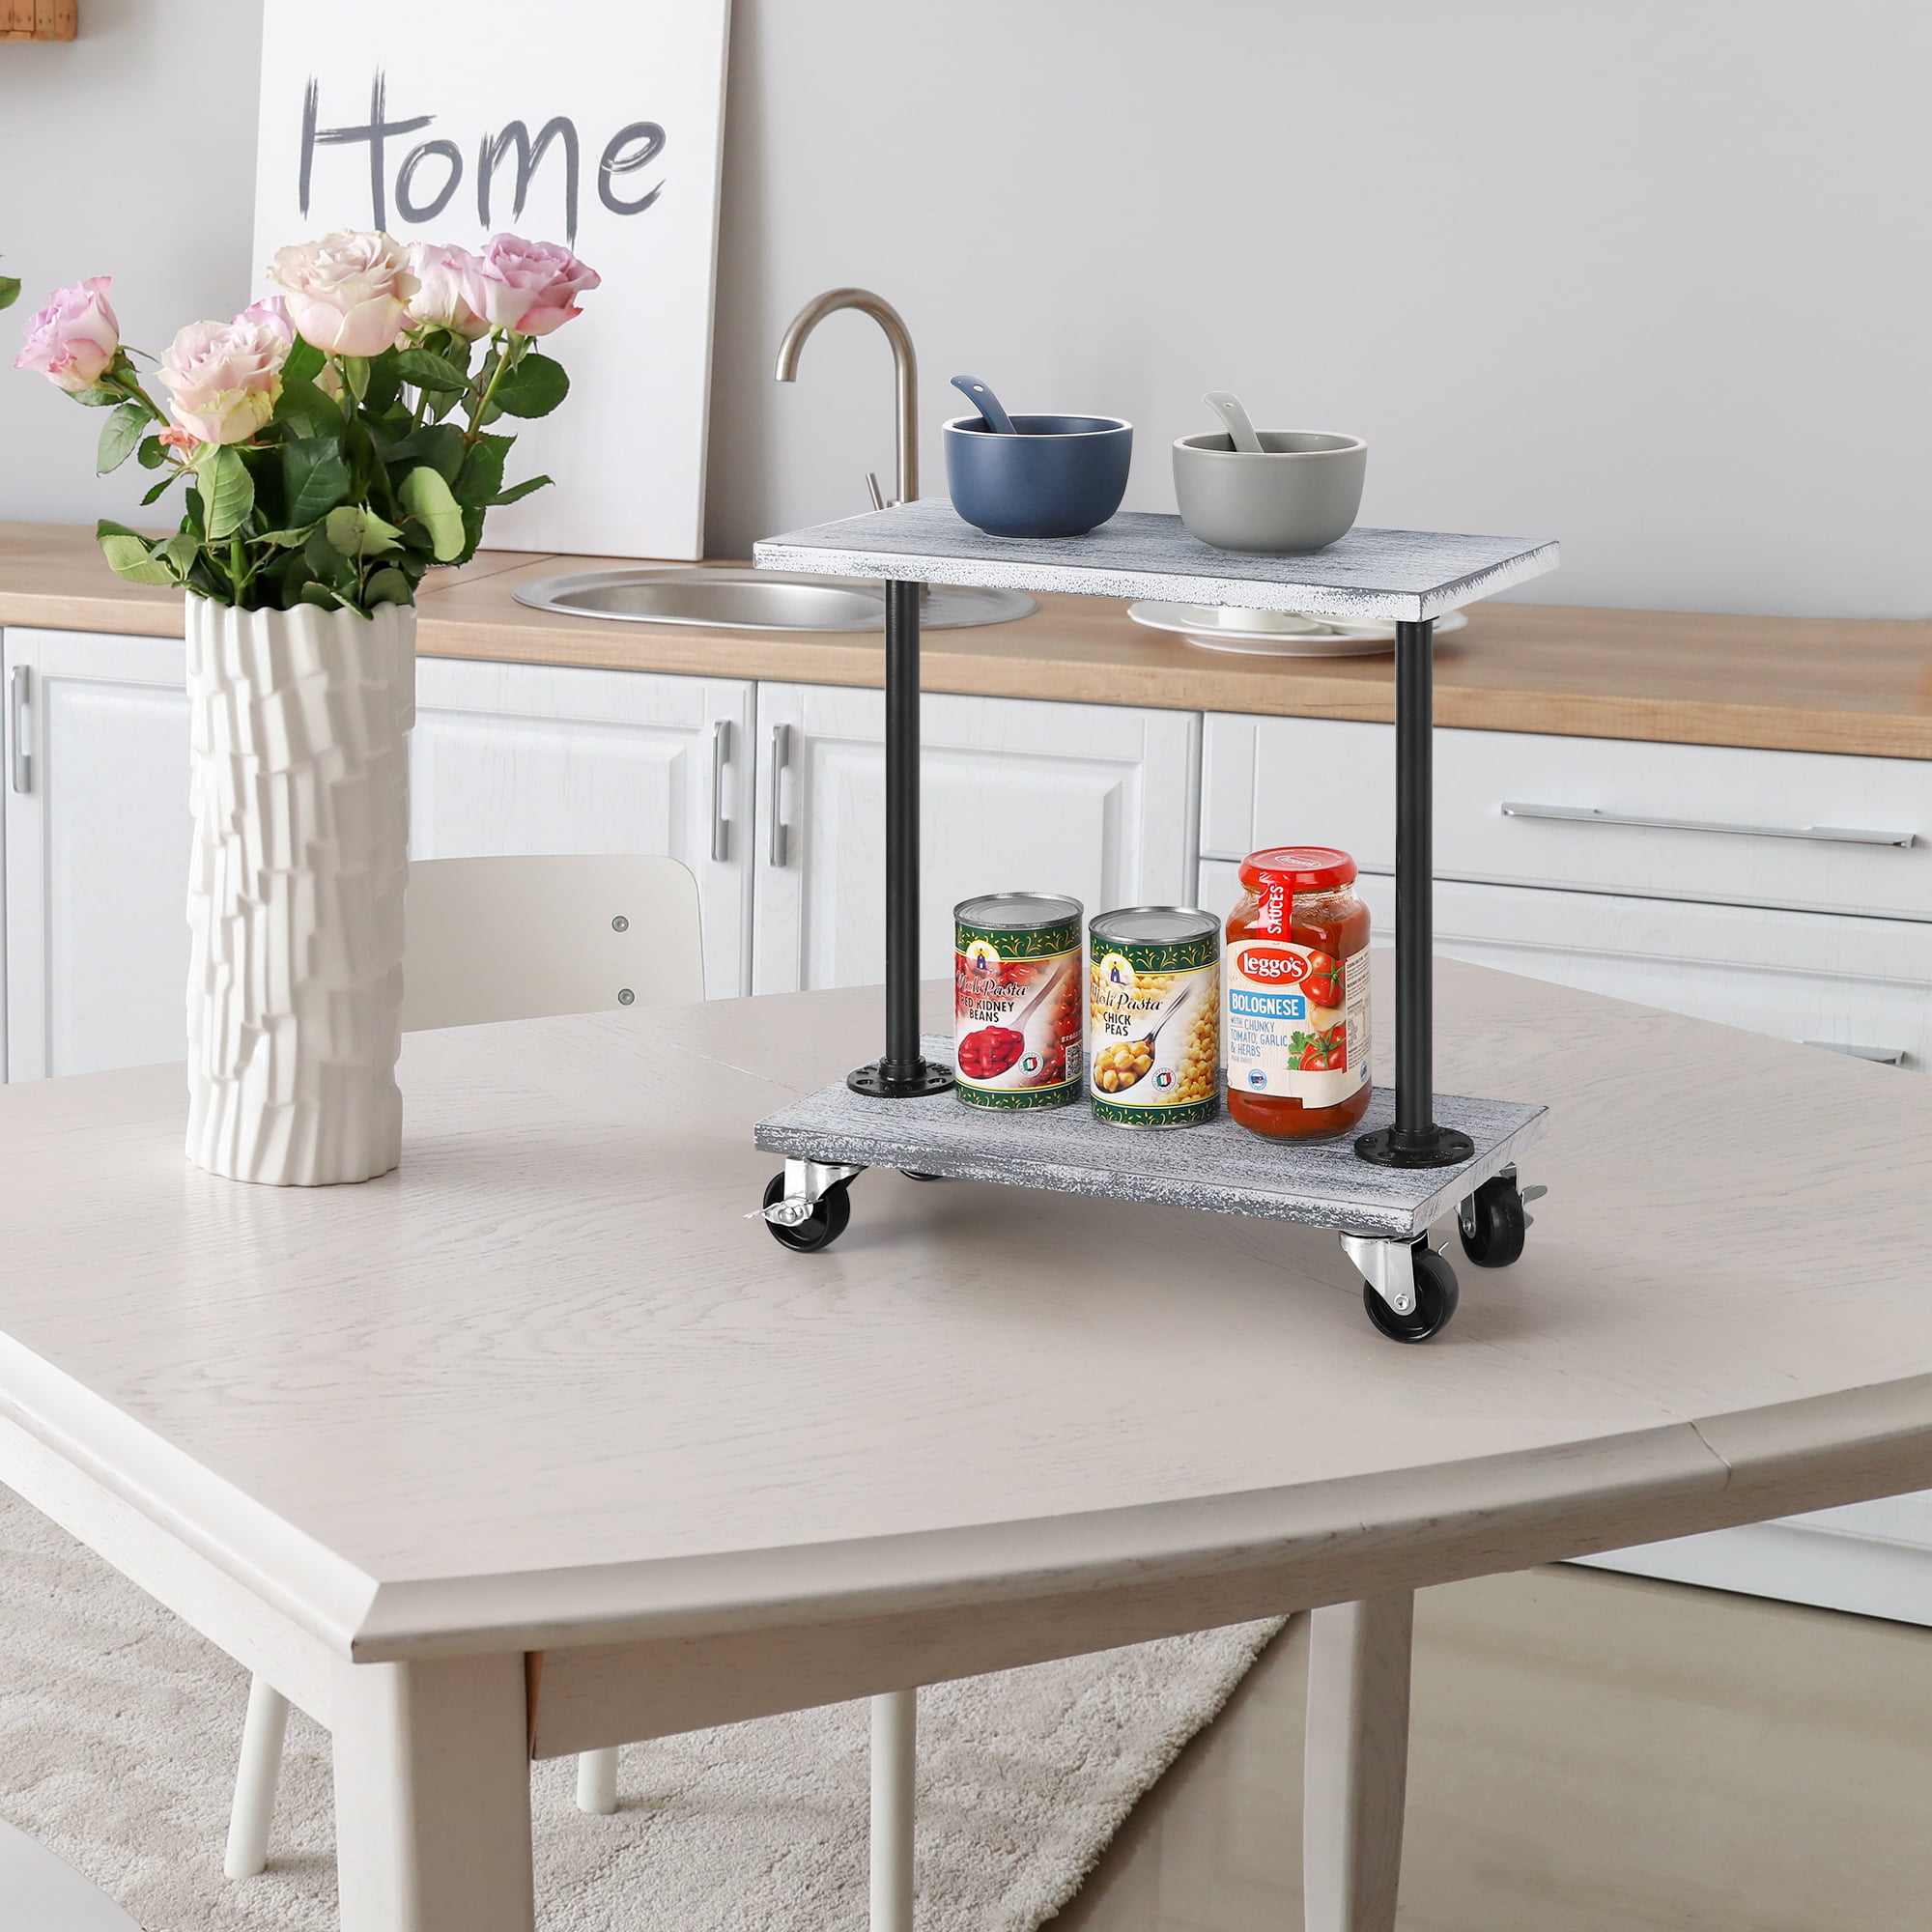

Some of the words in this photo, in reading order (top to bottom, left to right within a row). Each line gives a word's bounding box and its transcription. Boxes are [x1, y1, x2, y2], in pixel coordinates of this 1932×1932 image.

[298, 56, 667, 252] Home
[1266, 884, 1285, 935] SAUCES
[1242, 952, 1304, 979] Leggo's
[982, 978, 1029, 997] Pasta
[960, 994, 975, 1008] RED
[976, 998, 1015, 1013] KIDNEY
[1115, 991, 1161, 1011] Pasta
[1232, 992, 1300, 1017] BOLOGNESE
[969, 1009, 1000, 1023] BEANS
[1103, 1011, 1132, 1026] CHICK
[1243, 1018, 1275, 1033] CHUNKY
[1105, 1022, 1129, 1037] PEAS
[1237, 1042, 1262, 1058] HERBS
[1260, 1034, 1289, 1047] GARLIC
